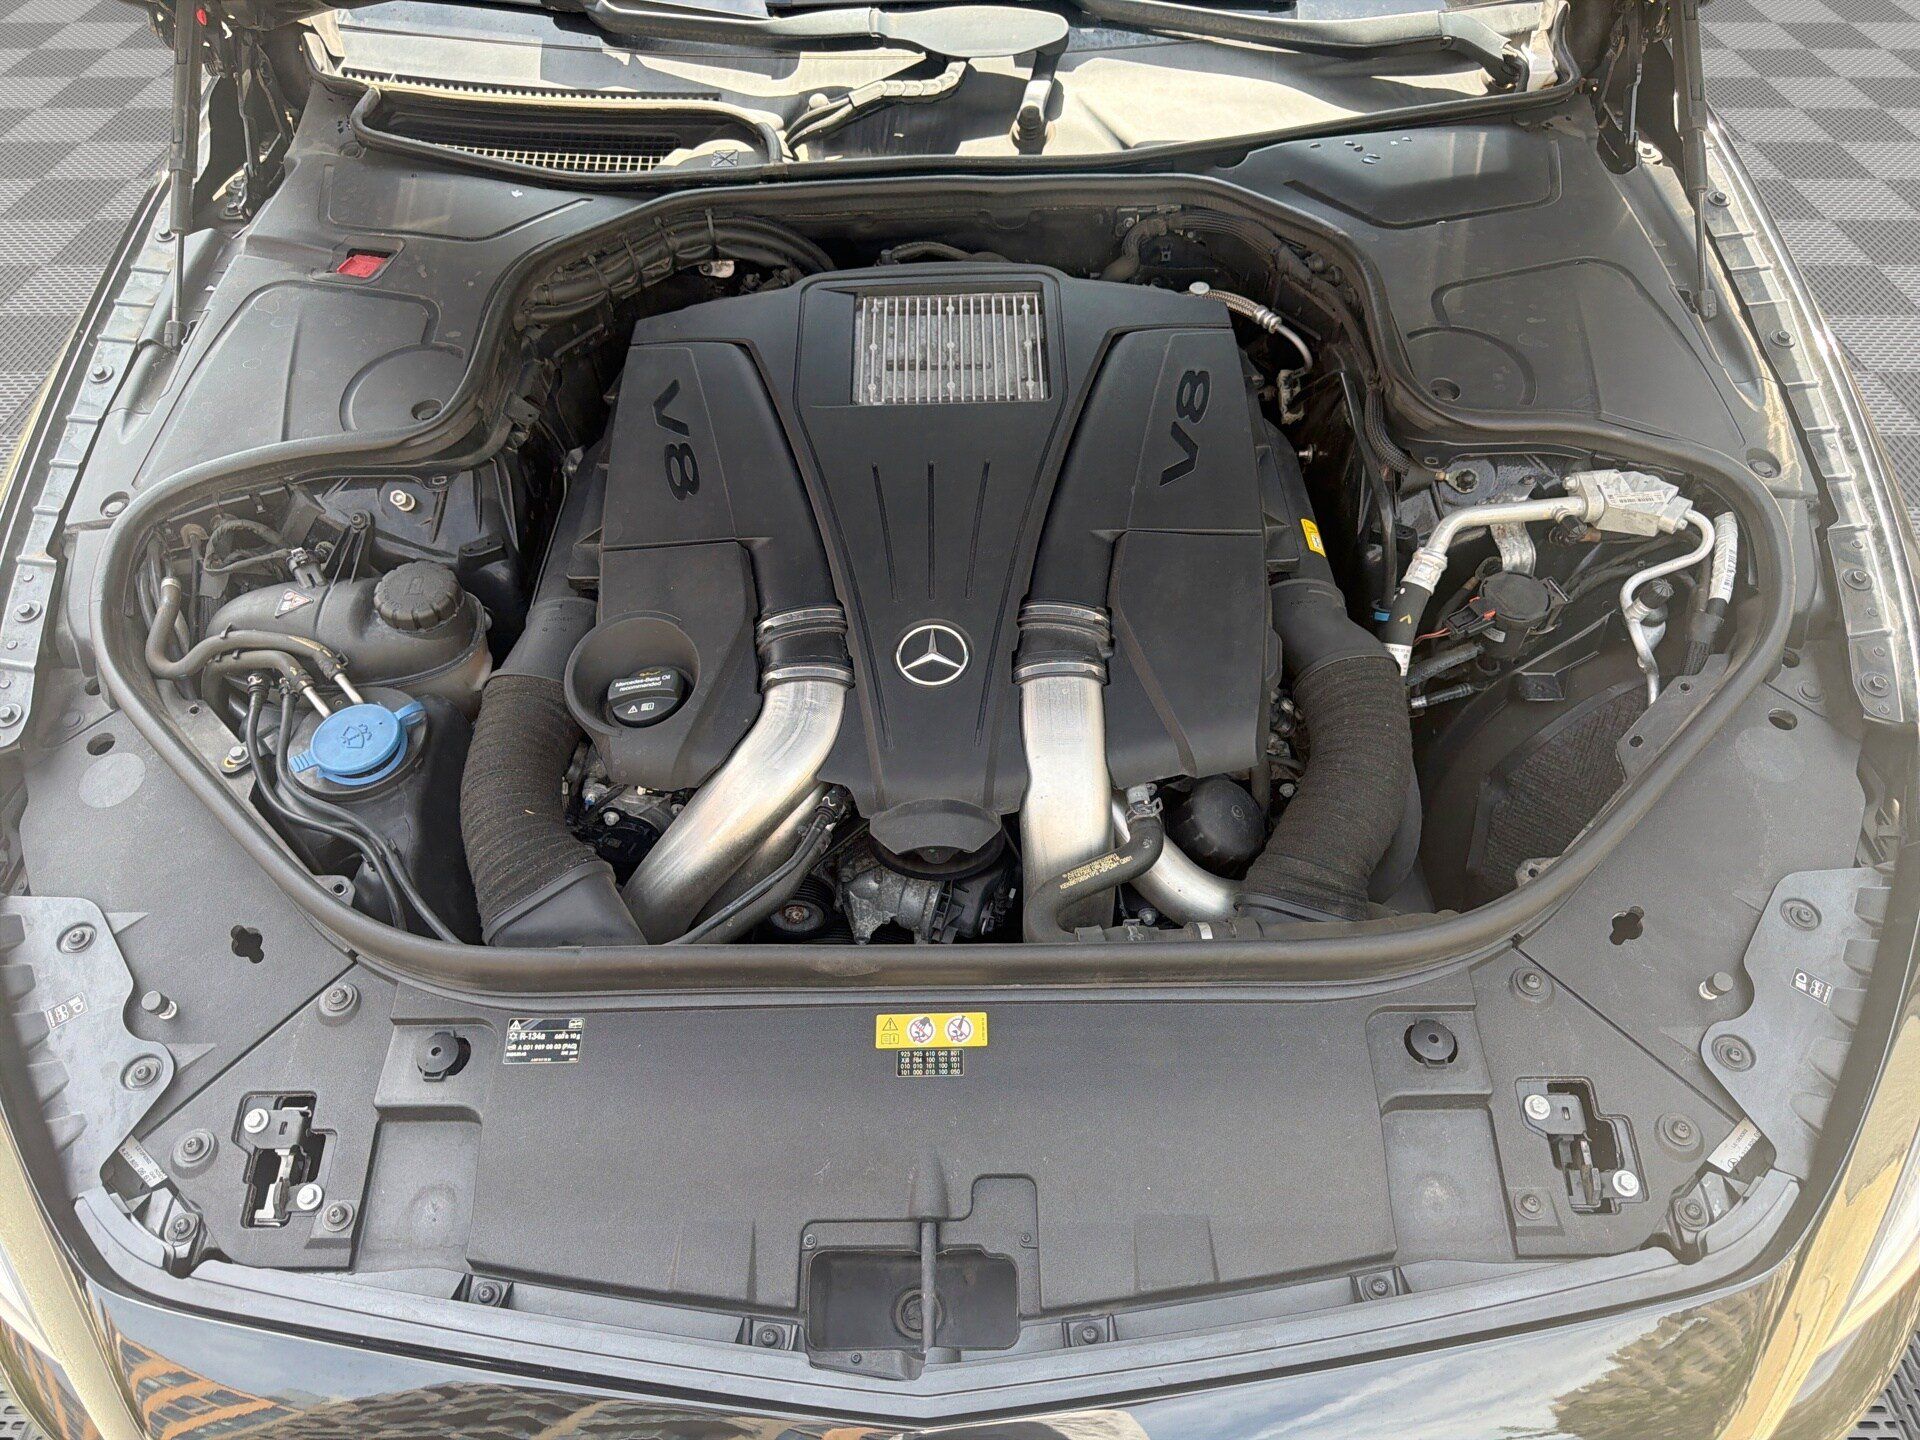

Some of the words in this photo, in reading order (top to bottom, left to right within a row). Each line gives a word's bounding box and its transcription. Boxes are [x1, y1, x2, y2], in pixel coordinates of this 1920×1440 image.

[1159, 370, 1211, 487] V8
[652, 378, 700, 502] V8
[615, 676, 660, 688] Mercedes-Benz
[619, 680, 662, 692] recommended
[520, 1032, 546, 1040] R-134a
